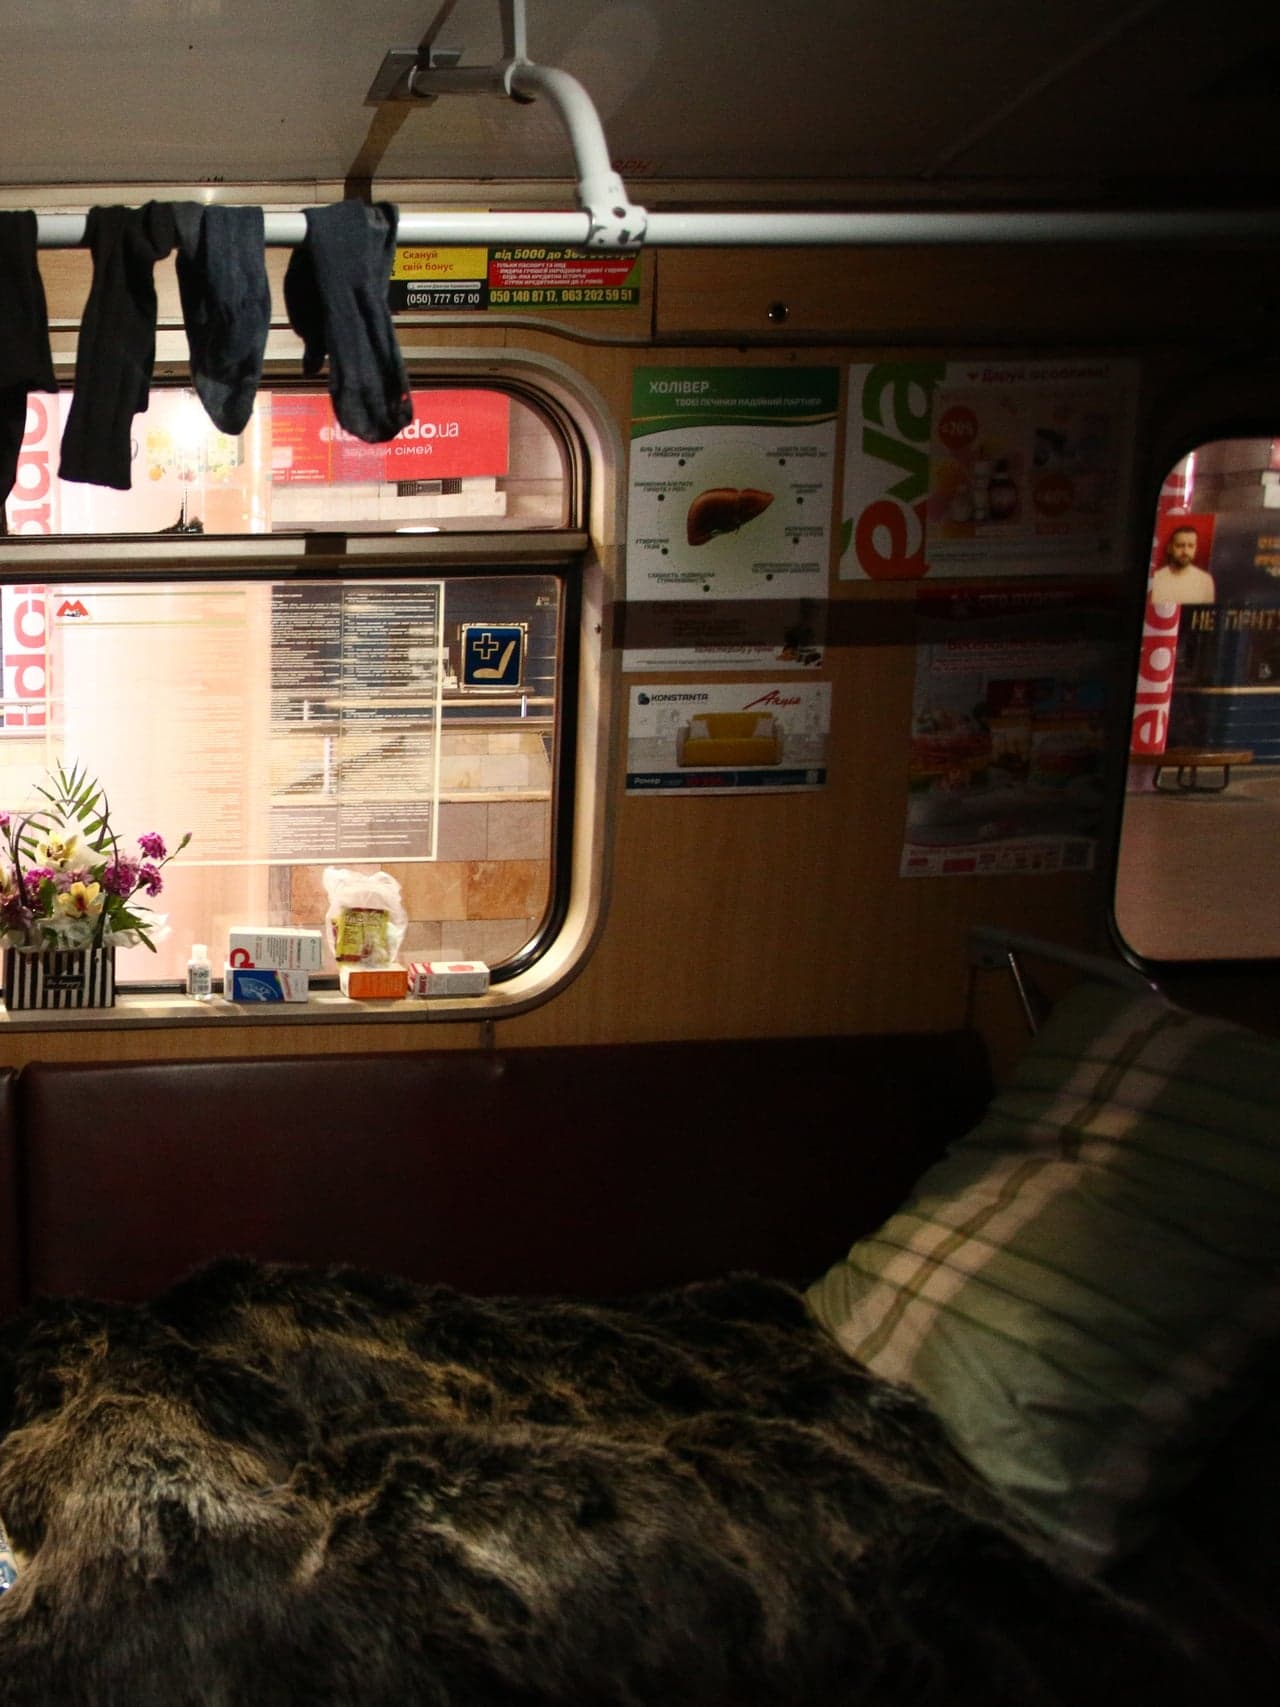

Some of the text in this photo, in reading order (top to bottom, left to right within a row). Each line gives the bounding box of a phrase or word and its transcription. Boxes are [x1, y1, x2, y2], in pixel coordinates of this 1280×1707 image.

[402, 250, 438, 260] Скануй
[514, 249, 546, 259] 5000
[425, 262, 454, 272] бонус
[406, 293, 480, 305] (050) 777 67 00
[490, 290, 510, 303] 050
[583, 289, 604, 302] 202
[620, 289, 632, 302] 51
[649, 381, 710, 394] ХОЛІВЕР
[395, 443, 433, 457] сімей
[856, 361, 947, 580] eva
[1225, 608, 1280, 631] ПРИТ
[651, 693, 709, 702] KONSTANTA
